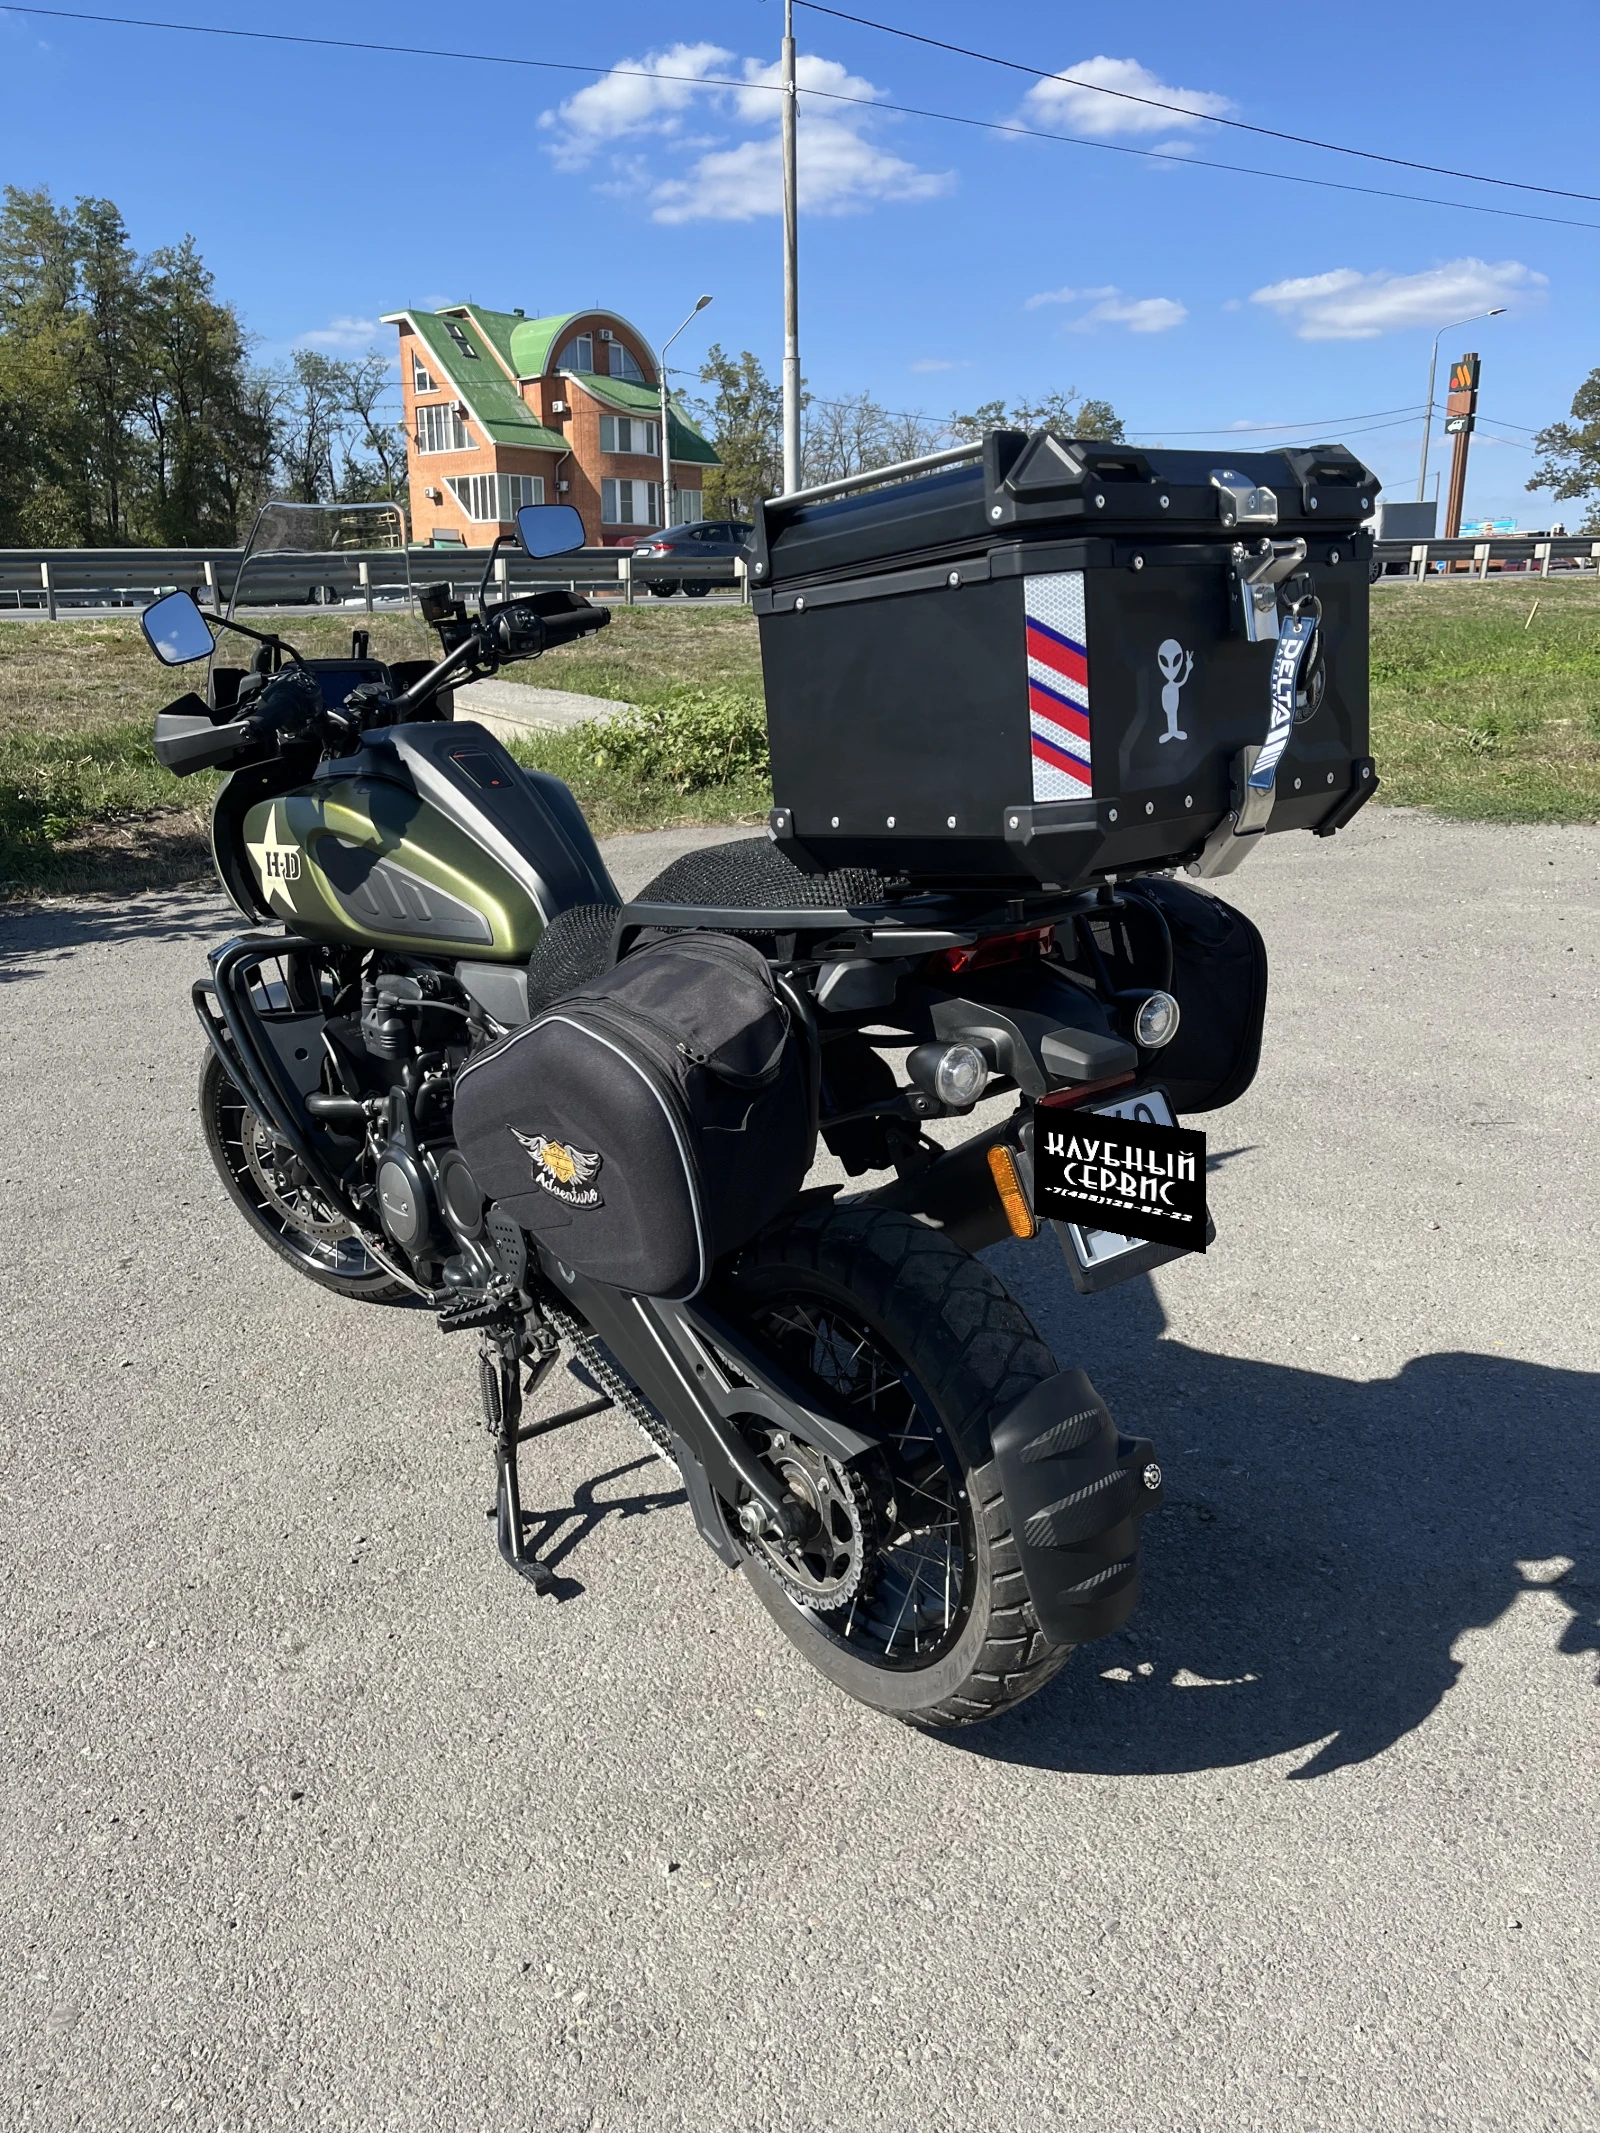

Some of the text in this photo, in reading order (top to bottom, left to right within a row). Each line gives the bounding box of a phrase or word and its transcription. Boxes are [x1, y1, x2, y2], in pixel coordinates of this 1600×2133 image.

[1270, 638, 1304, 729] DELTA
[1272, 638, 1286, 698] BATTERY
[535, 1172, 598, 1204] Adventure
